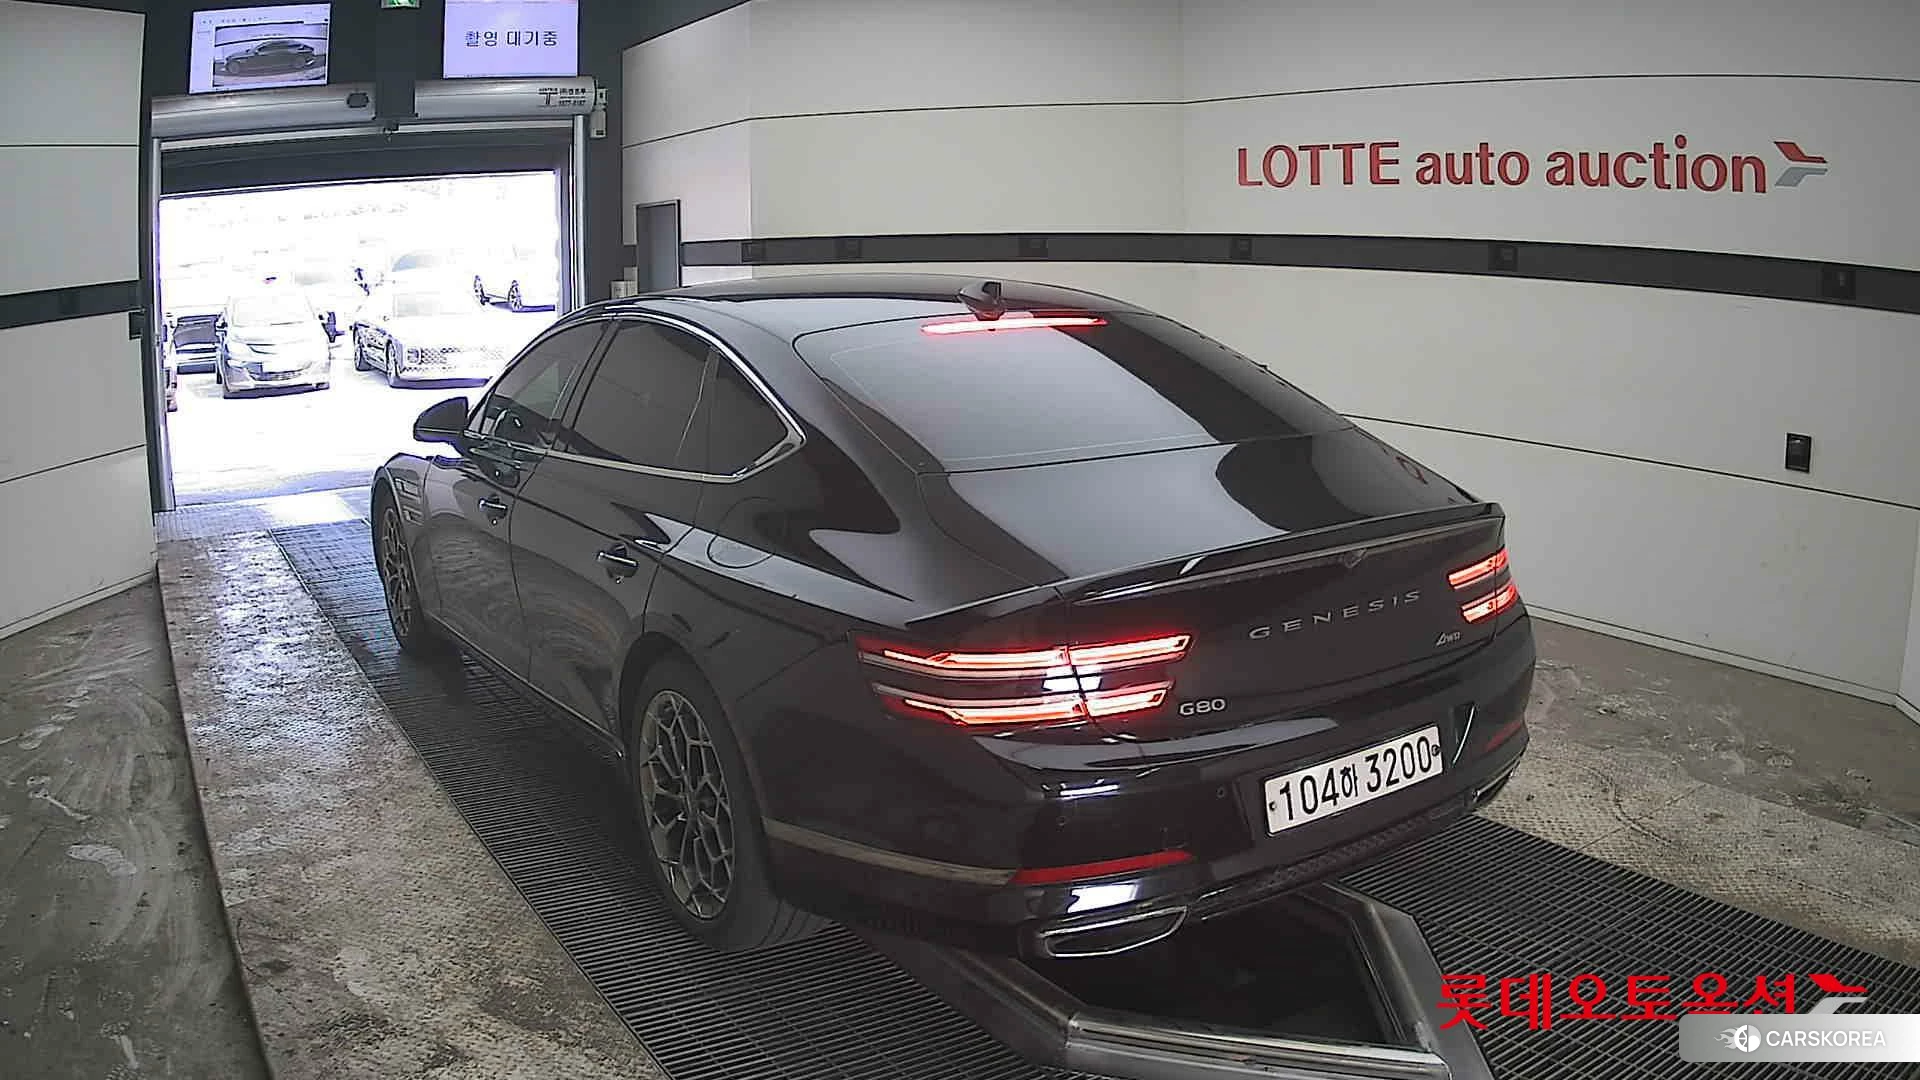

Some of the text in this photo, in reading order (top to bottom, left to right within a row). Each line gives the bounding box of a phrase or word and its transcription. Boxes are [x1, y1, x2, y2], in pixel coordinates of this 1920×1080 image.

[506, 31, 558, 47] 대기중
[1238, 134, 1767, 193] LOTTE auto auction
[1249, 590, 1420, 639] GENESIS
[1179, 698, 1226, 716] G80
[1365, 736, 1432, 793] 3200
